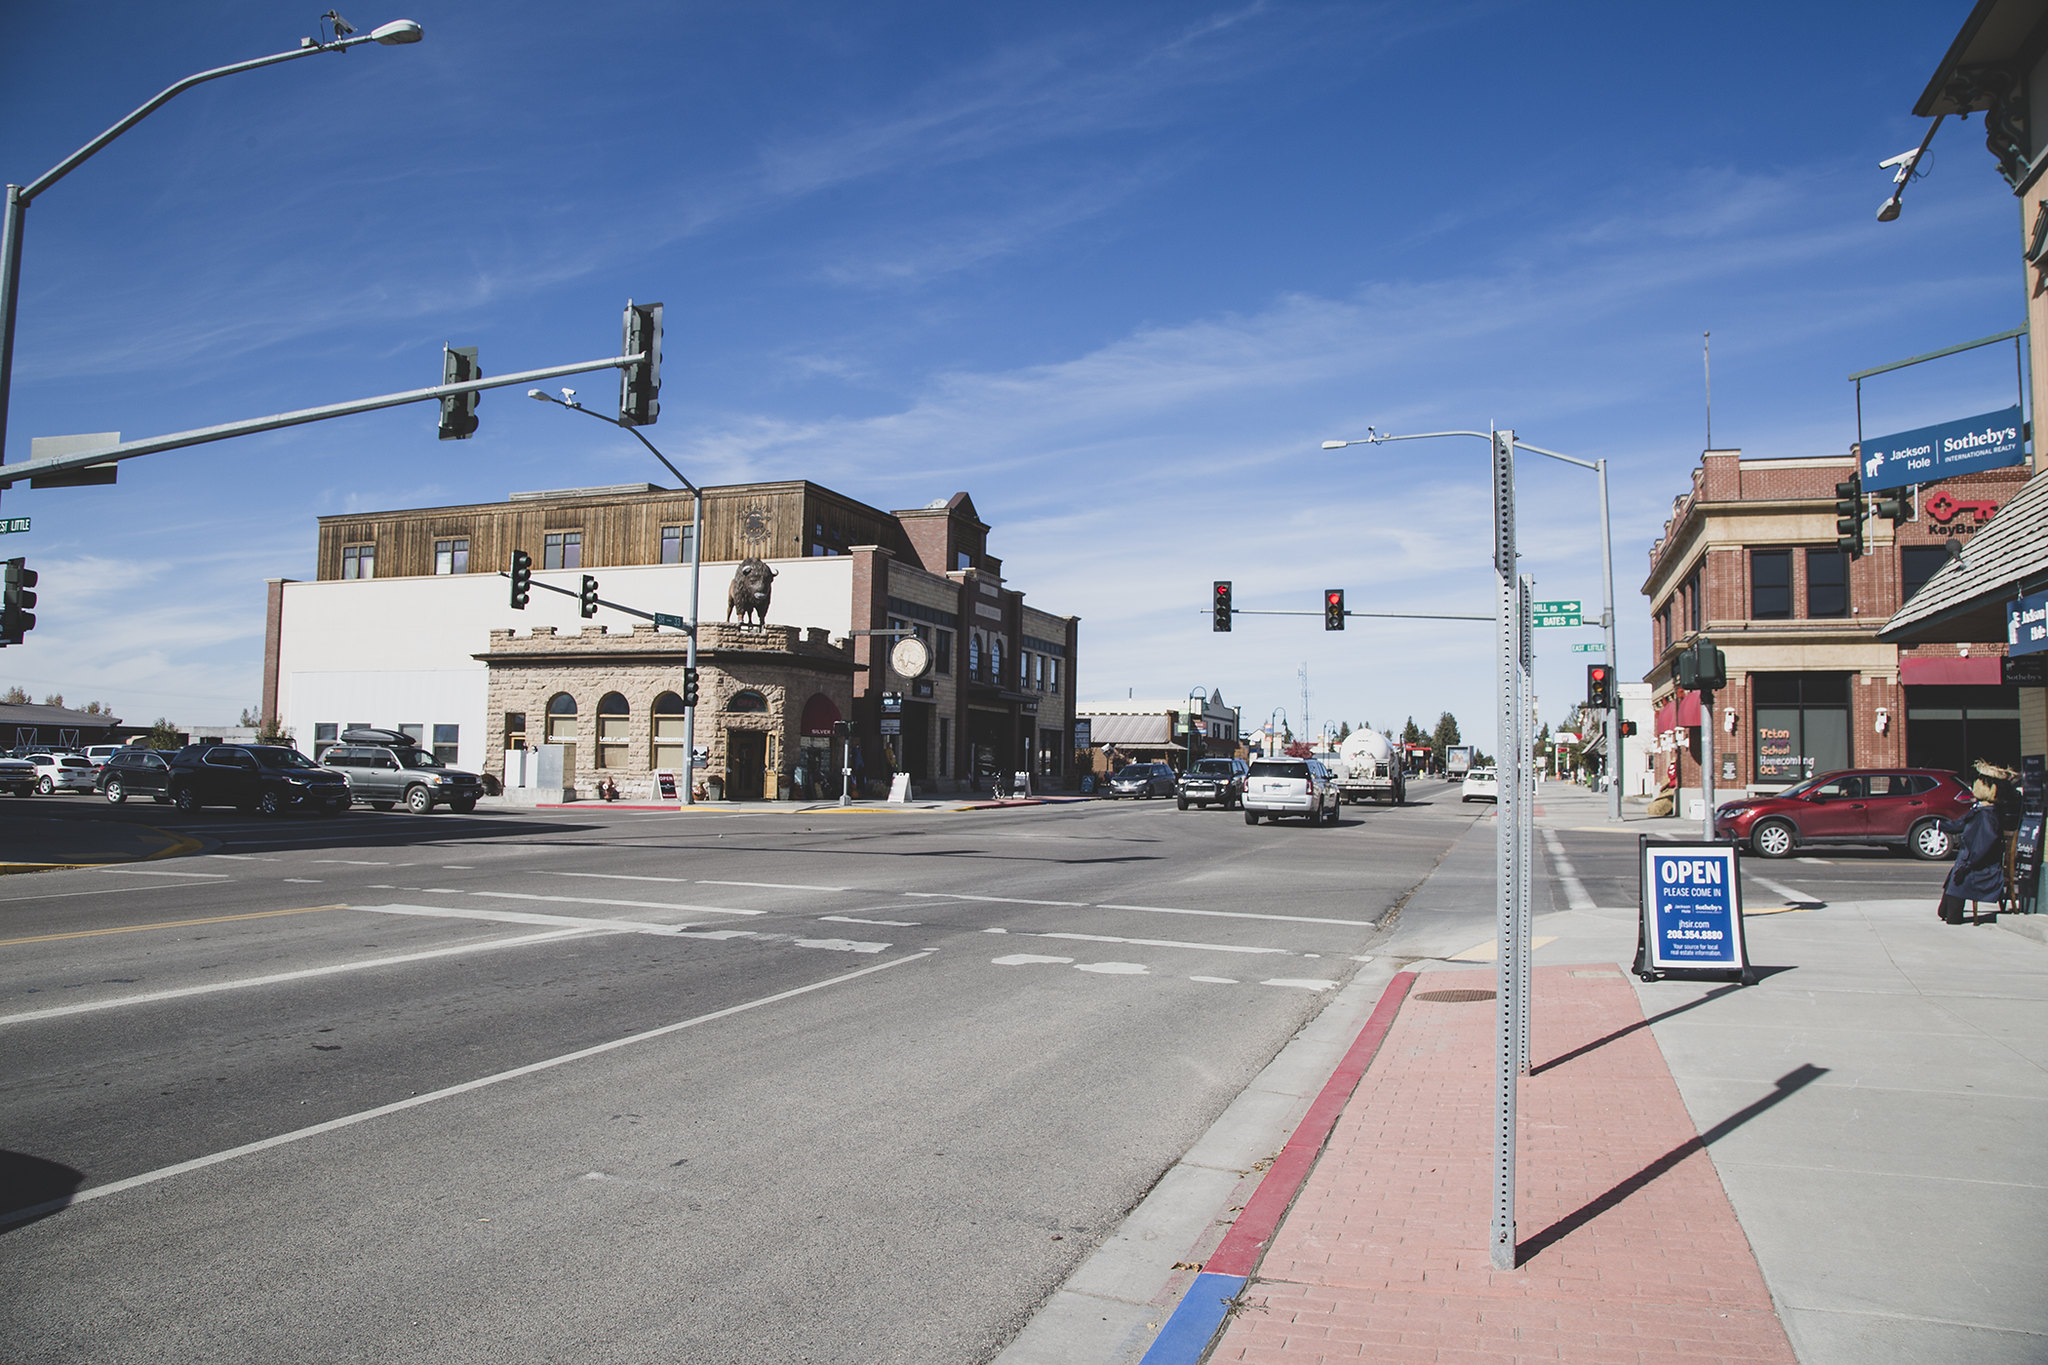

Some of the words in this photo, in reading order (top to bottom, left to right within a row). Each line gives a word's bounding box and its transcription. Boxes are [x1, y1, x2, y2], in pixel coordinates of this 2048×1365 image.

[1943, 427, 2017, 453] Sotheby's
[1890, 445, 1931, 461] Jackson
[1944, 449, 1993, 463] INTERNATIONAL
[1993, 443, 2017, 454] REALTY
[1907, 457, 1931, 470] Hole
[10, 519, 30, 531] LITTLE
[1533, 604, 1548, 612] HILL
[1543, 616, 1567, 626] BATES
[1760, 728, 1790, 739] Teton
[1761, 745, 1790, 755] School
[1760, 765, 1778, 775] Oct
[1661, 860, 1721, 884] OPEN
[1663, 887, 1690, 897] PLEASE
[1691, 887, 1712, 897] COME
[1713, 887, 1722, 897] IN
